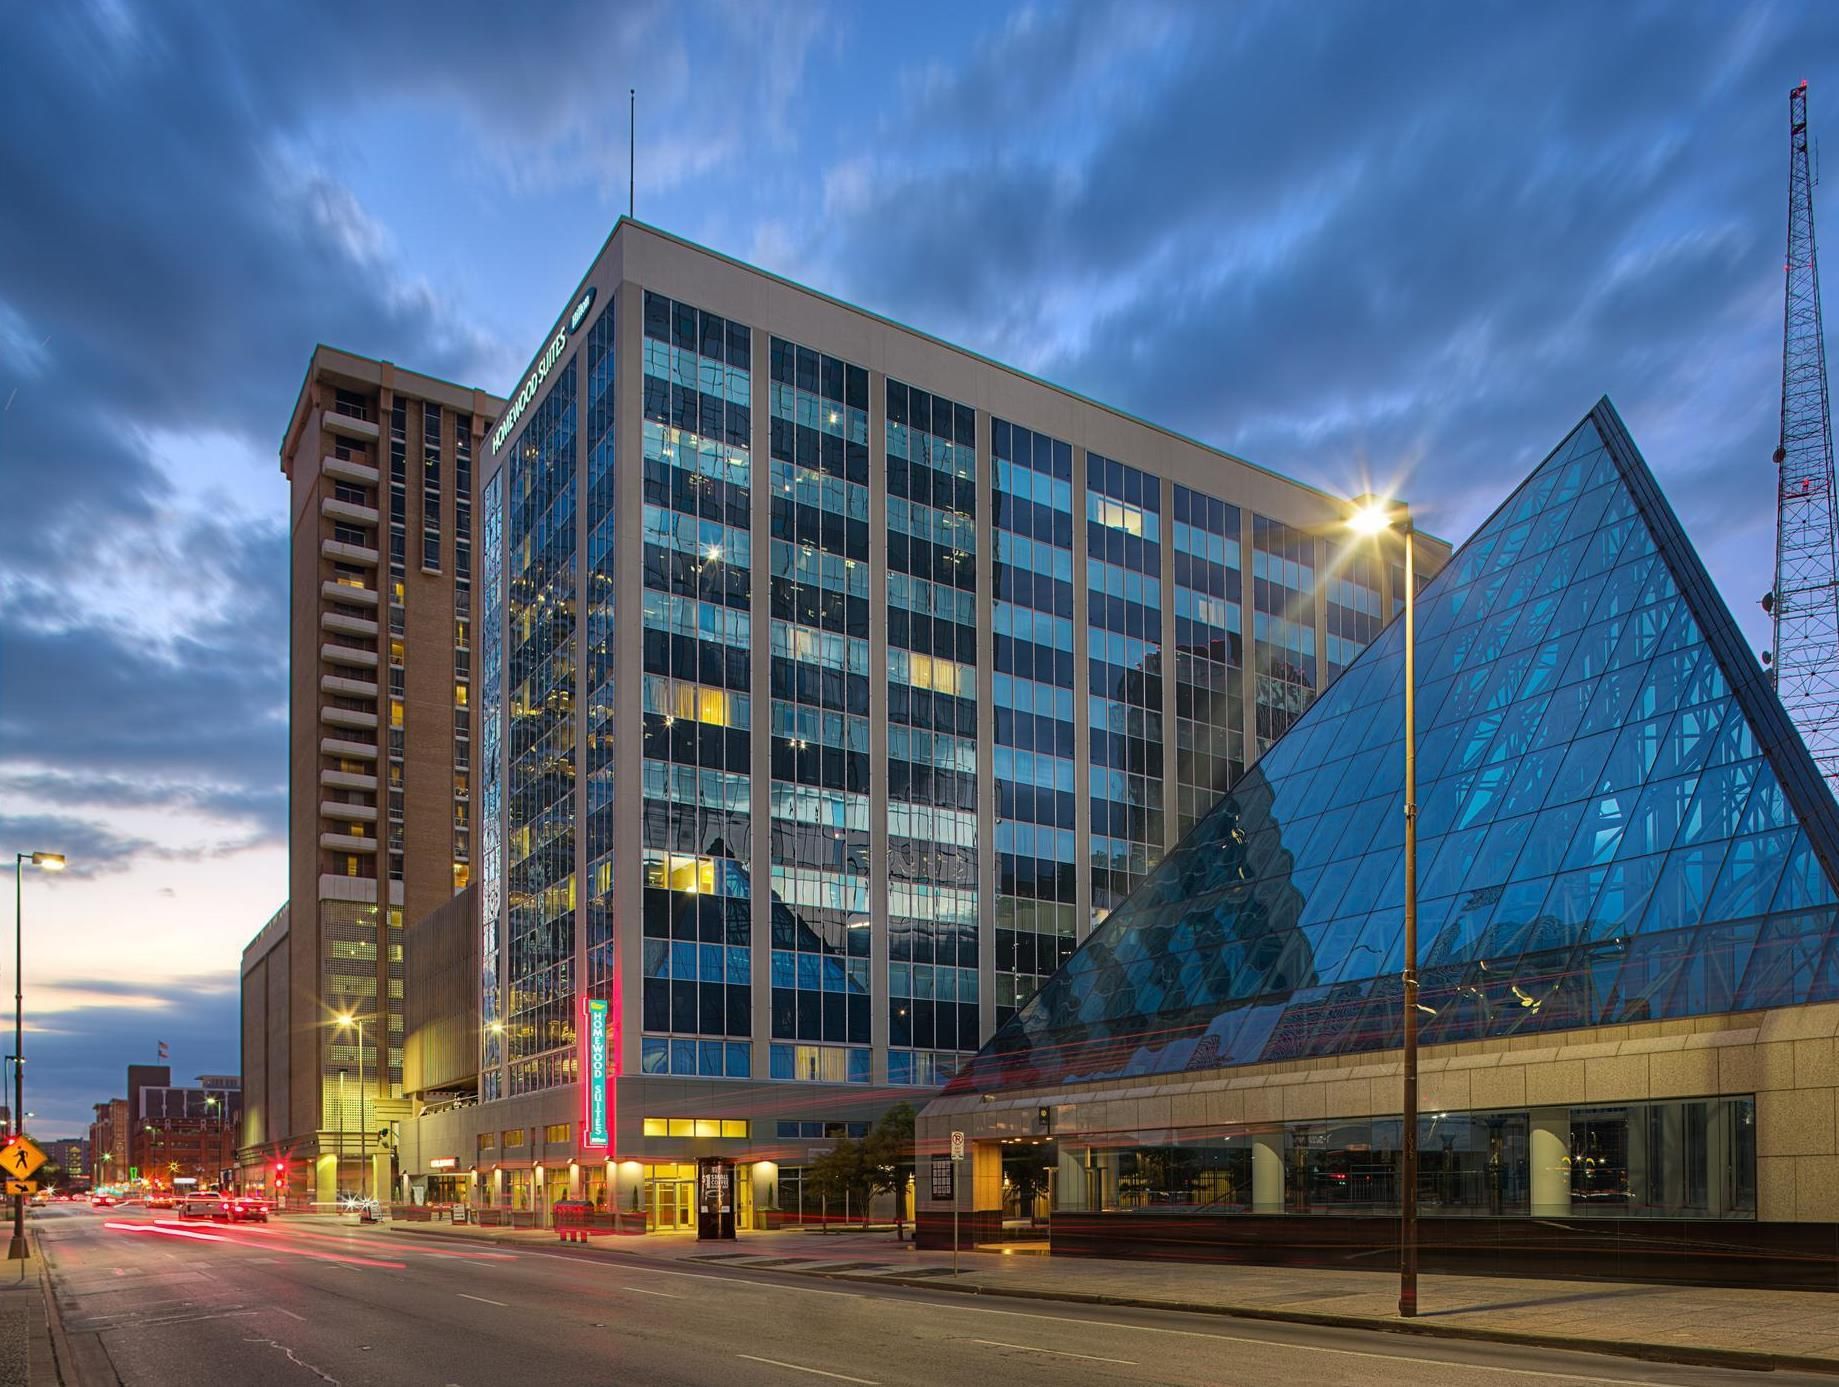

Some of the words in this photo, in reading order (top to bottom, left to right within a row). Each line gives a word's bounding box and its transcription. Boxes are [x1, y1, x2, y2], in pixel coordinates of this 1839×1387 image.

[492, 373, 538, 455] HOMEWOOD
[537, 326, 567, 384] SUITES
[593, 1012, 603, 1078] HOMEWOOD
[594, 1085, 602, 1135] SUITES
